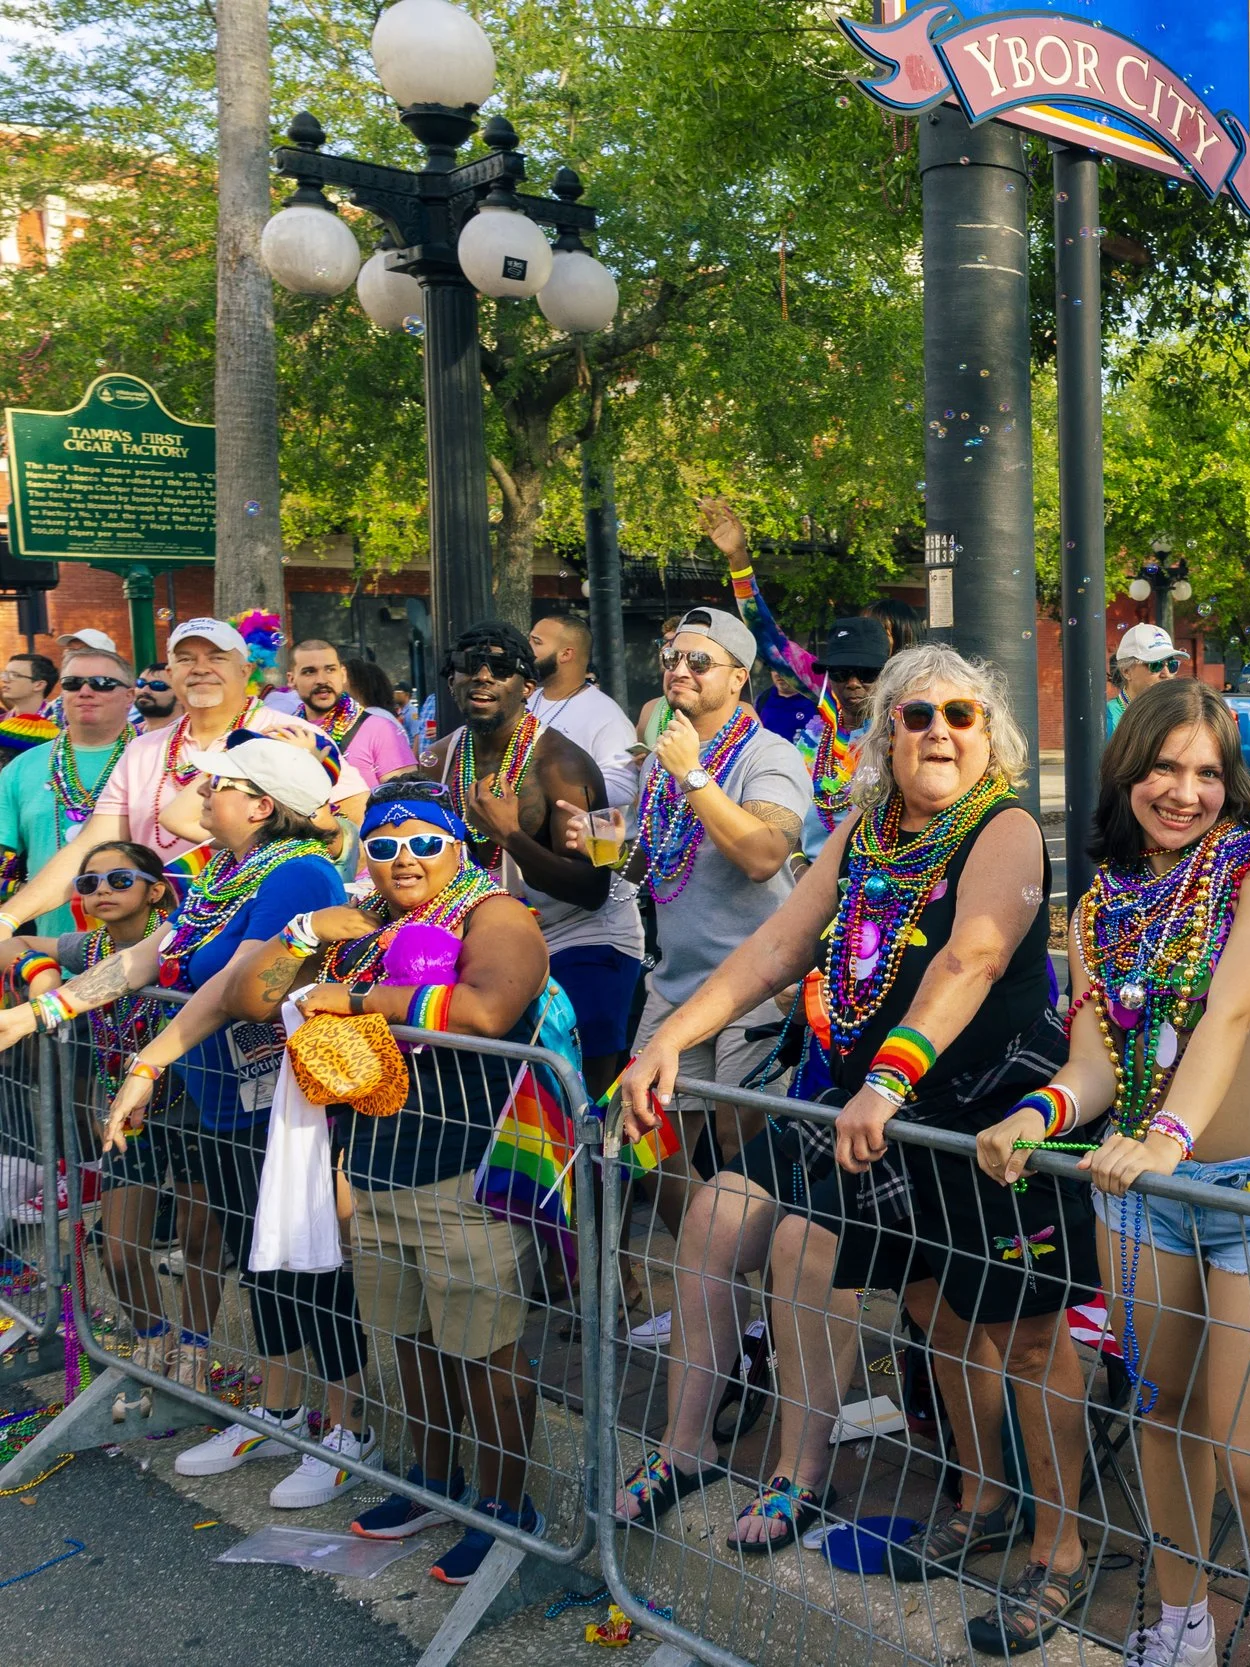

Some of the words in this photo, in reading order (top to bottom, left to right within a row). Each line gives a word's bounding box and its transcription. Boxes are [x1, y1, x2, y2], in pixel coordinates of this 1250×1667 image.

[963, 33, 1106, 97] YBOR
[1115, 55, 1222, 165] CITY
[67, 427, 133, 443] TAMPA'S
[141, 432, 184, 446] FIRST
[63, 439, 114, 453] CIGAR
[122, 443, 190, 458] FACTORY
[24, 462, 44, 470] The
[72, 465, 101, 473] Tampa
[105, 467, 131, 475] cigars
